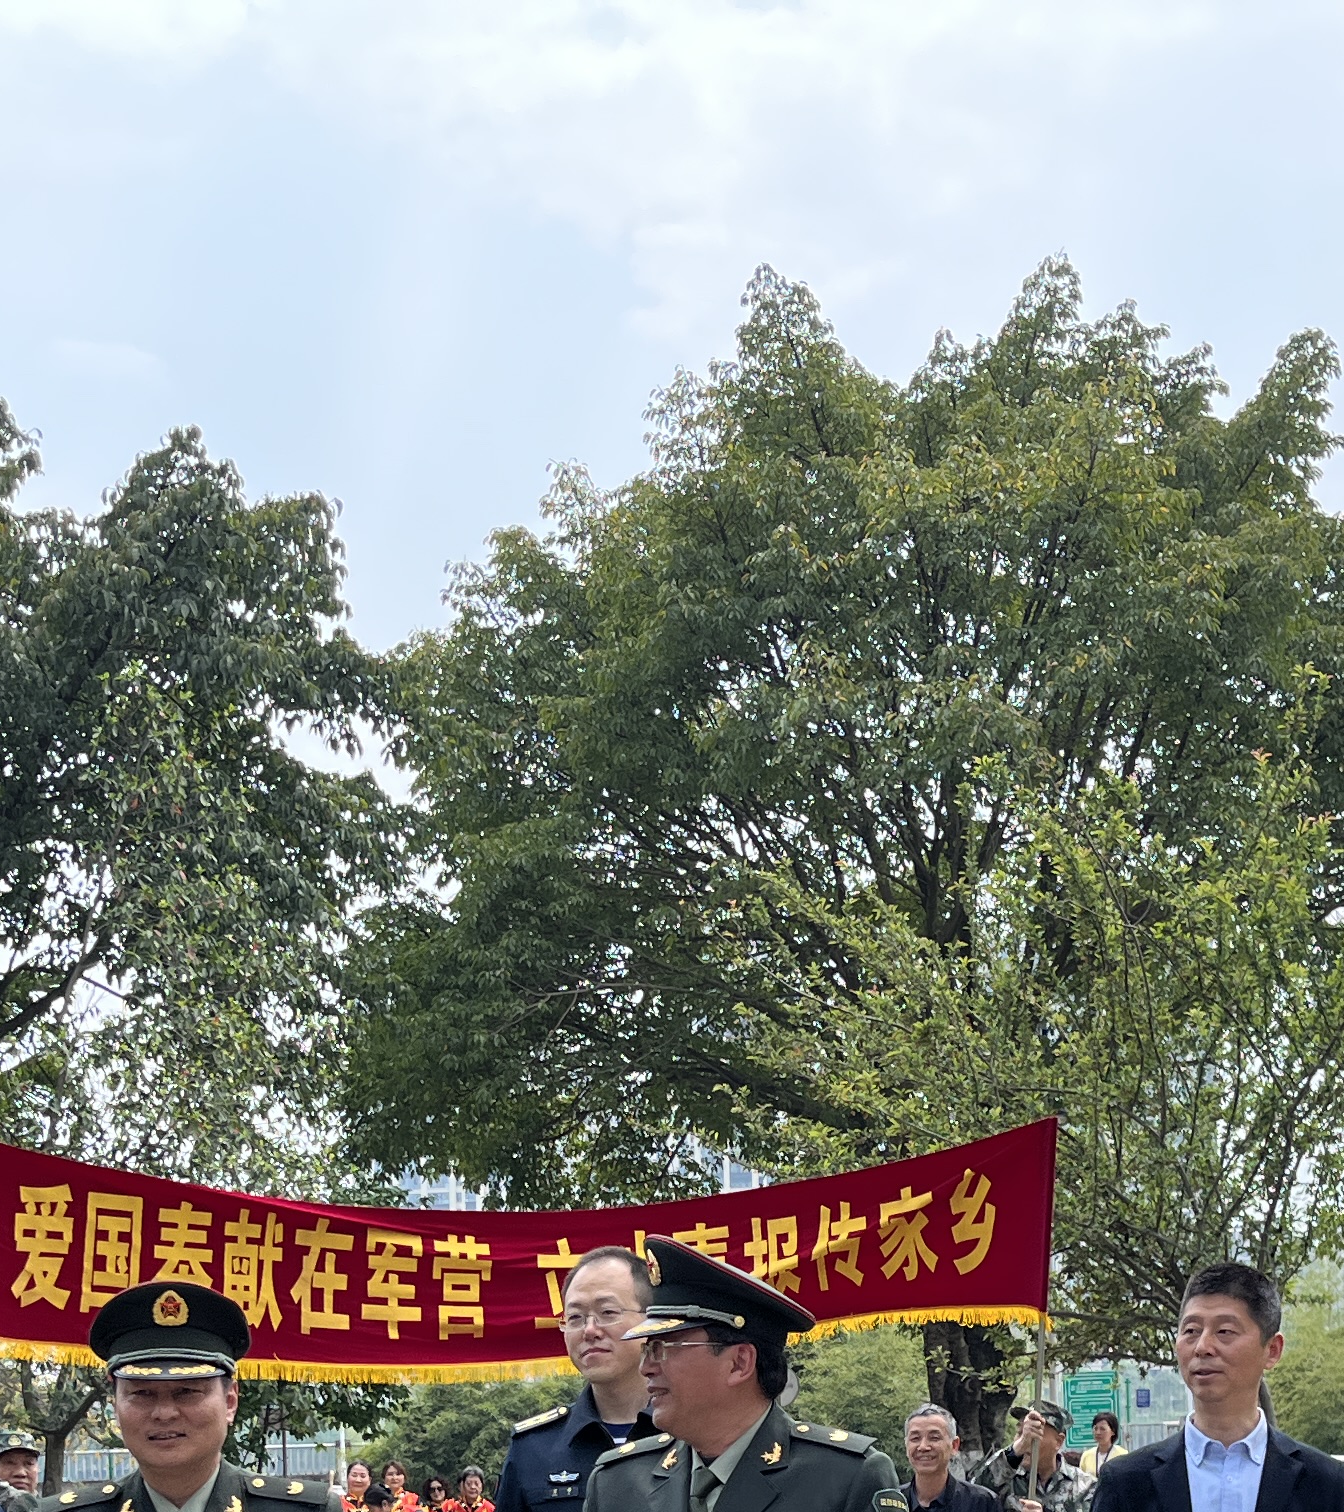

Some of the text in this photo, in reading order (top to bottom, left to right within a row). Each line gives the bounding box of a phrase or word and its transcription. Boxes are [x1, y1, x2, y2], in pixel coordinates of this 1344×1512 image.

[11, 1183, 493, 1341] 爱国奉献在军营
